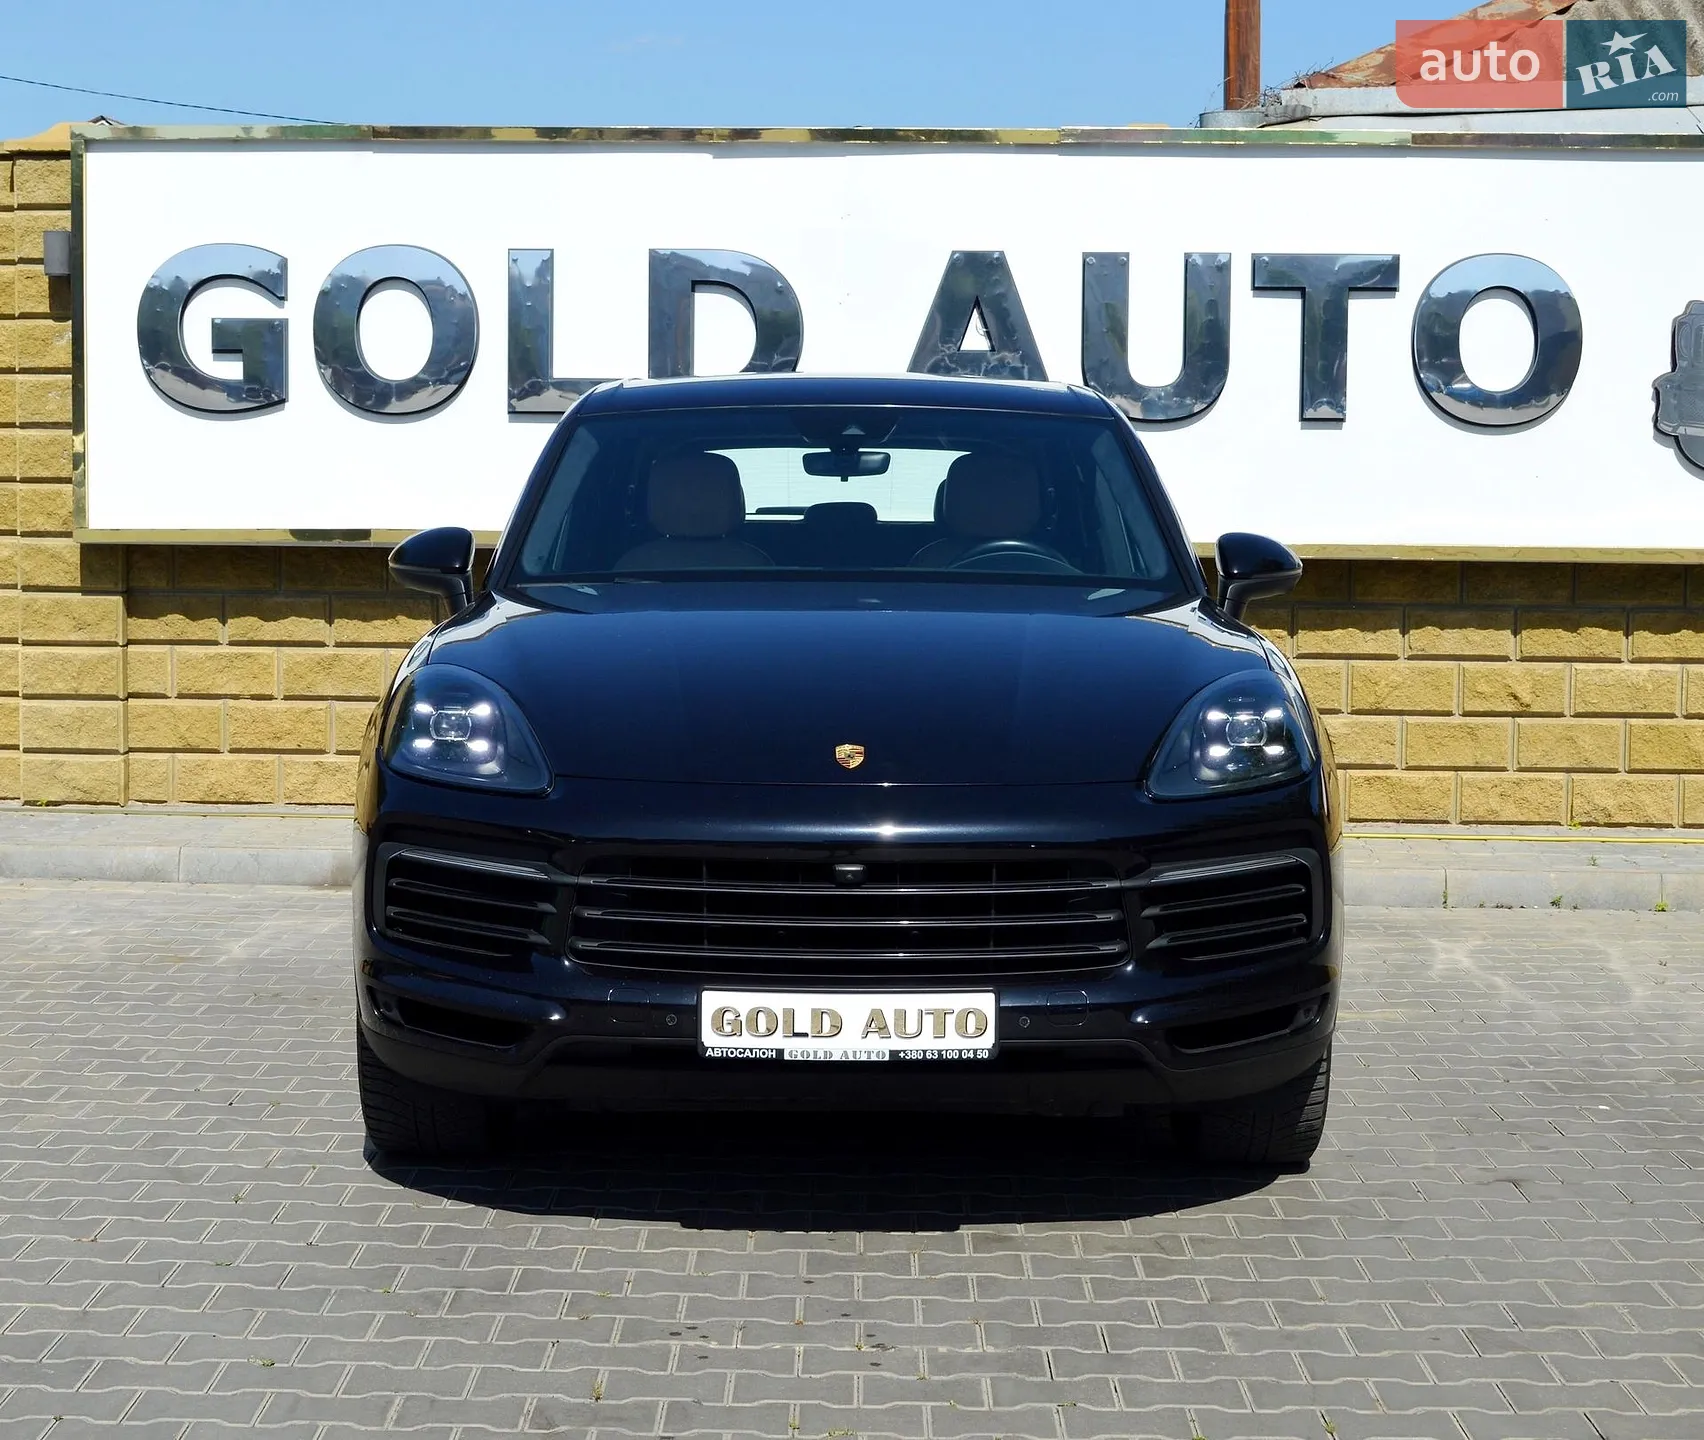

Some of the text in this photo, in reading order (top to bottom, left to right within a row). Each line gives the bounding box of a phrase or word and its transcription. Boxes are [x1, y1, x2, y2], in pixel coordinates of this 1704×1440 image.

[137, 243, 1583, 427] GOLD AUTO
[711, 1006, 989, 1039] GOLD AUTO
[705, 1047, 776, 1059] АВТОСАЛОН
[787, 1049, 887, 1060] GOLD AUTO
[898, 1049, 989, 1060] +380 63 100 04 50
